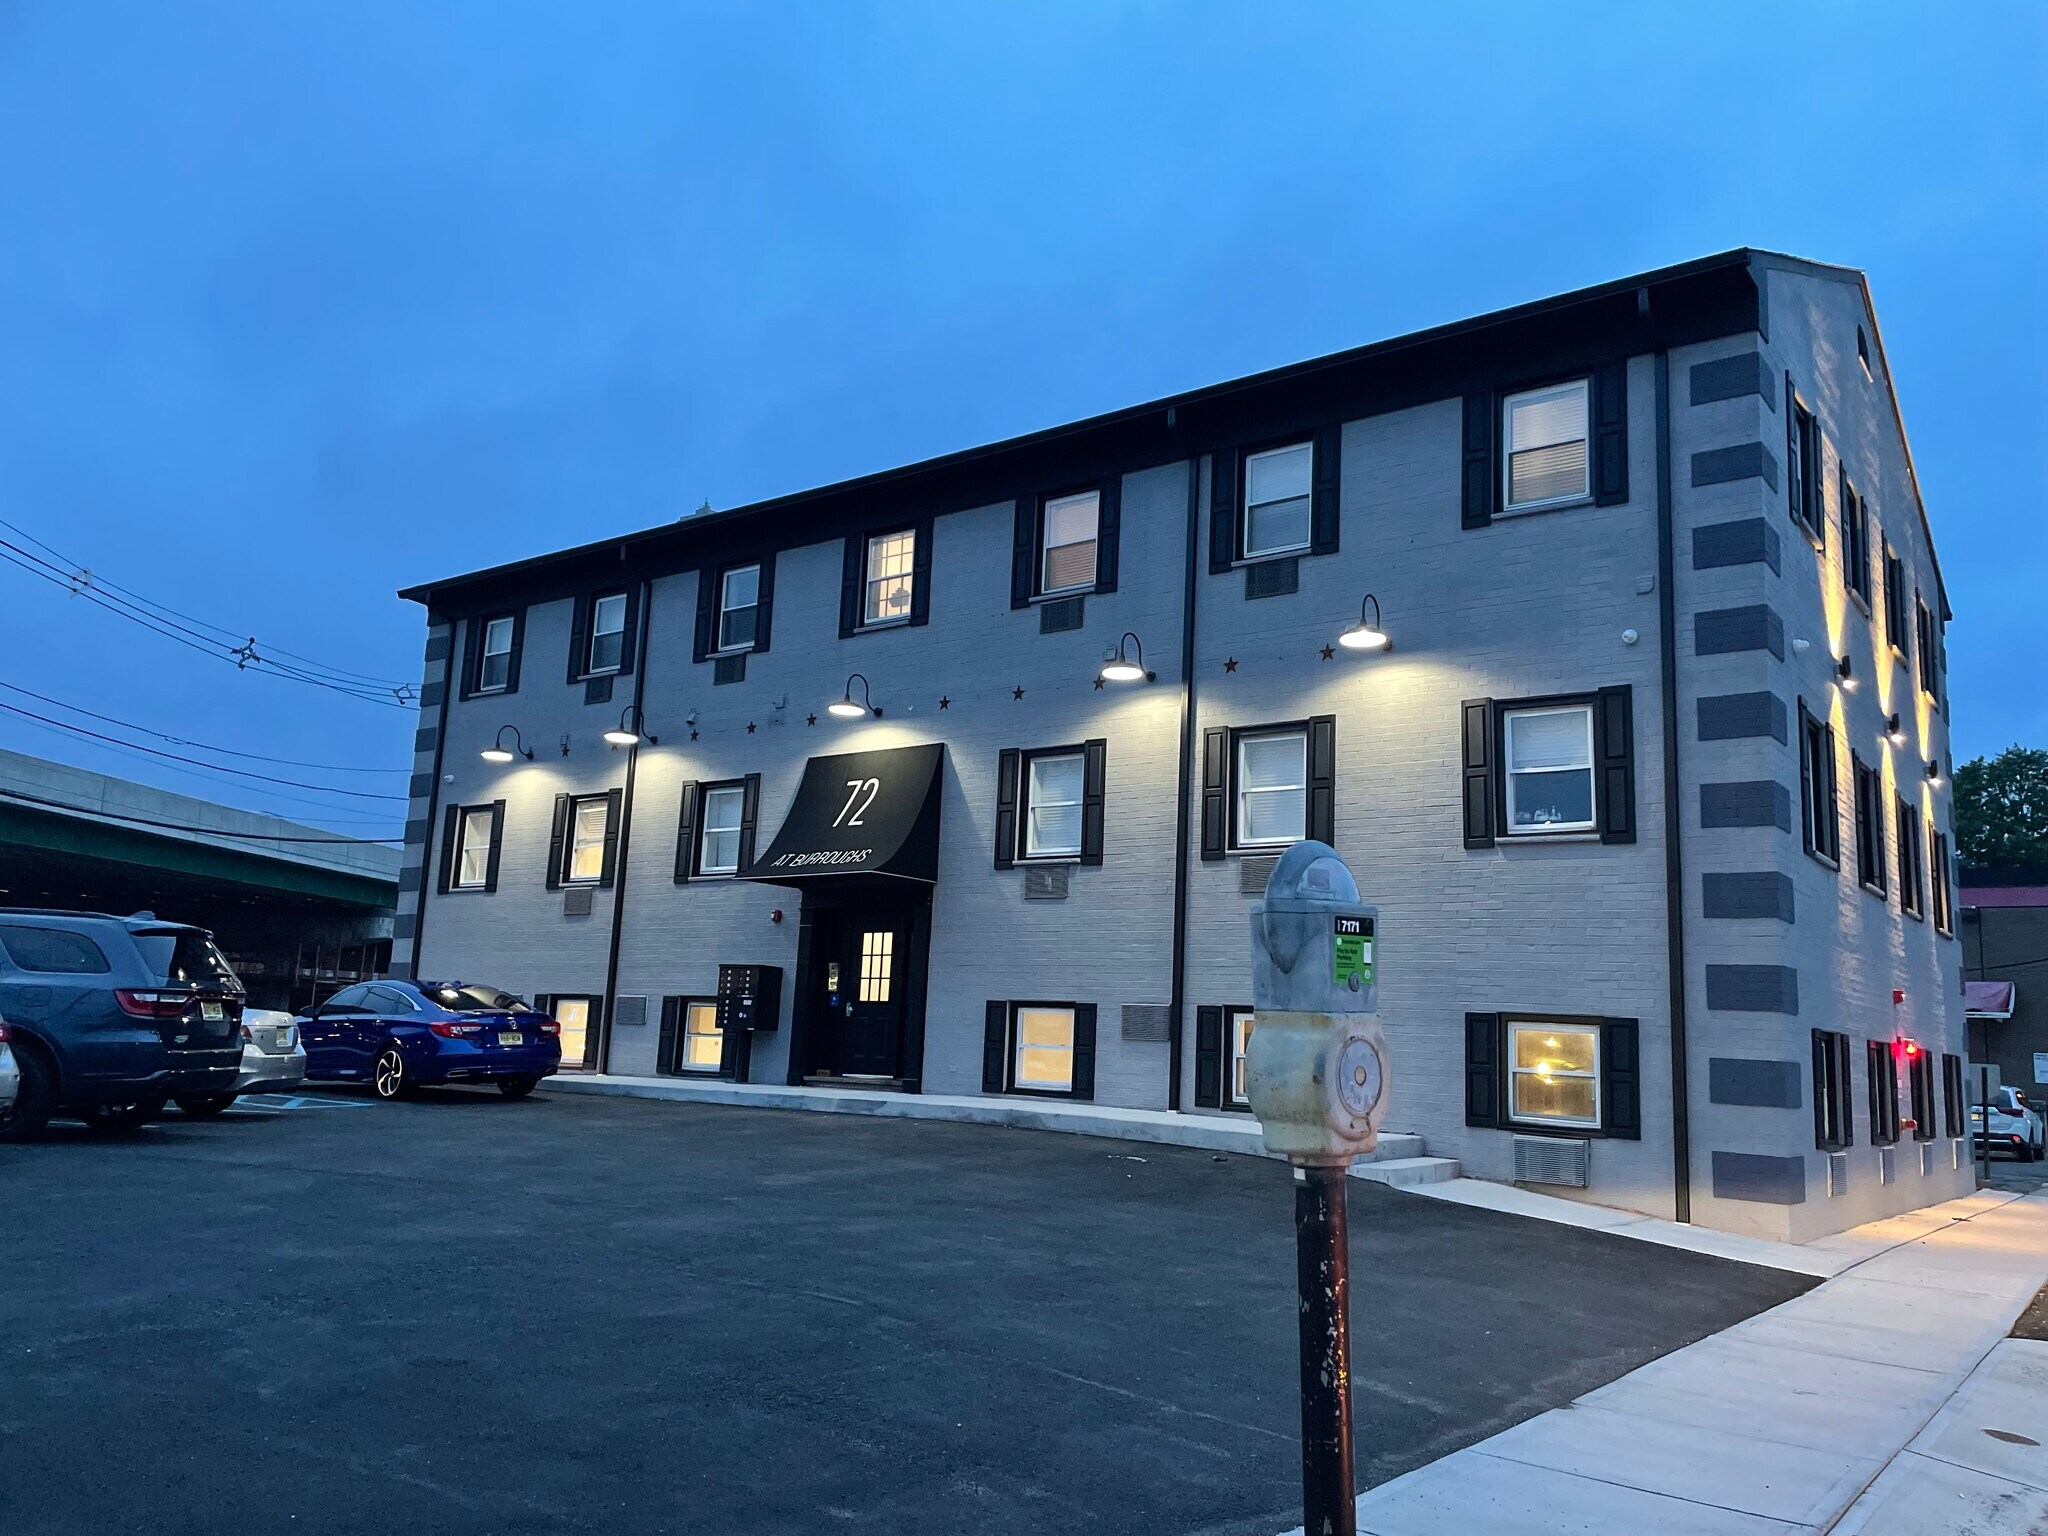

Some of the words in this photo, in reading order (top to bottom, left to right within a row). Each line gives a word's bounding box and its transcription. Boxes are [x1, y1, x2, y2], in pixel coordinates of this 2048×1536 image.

[832, 777, 880, 828] 72
[770, 853, 796, 867] AT
[788, 848, 873, 867] BURROUGHS
[1341, 920, 1360, 933] 7171
